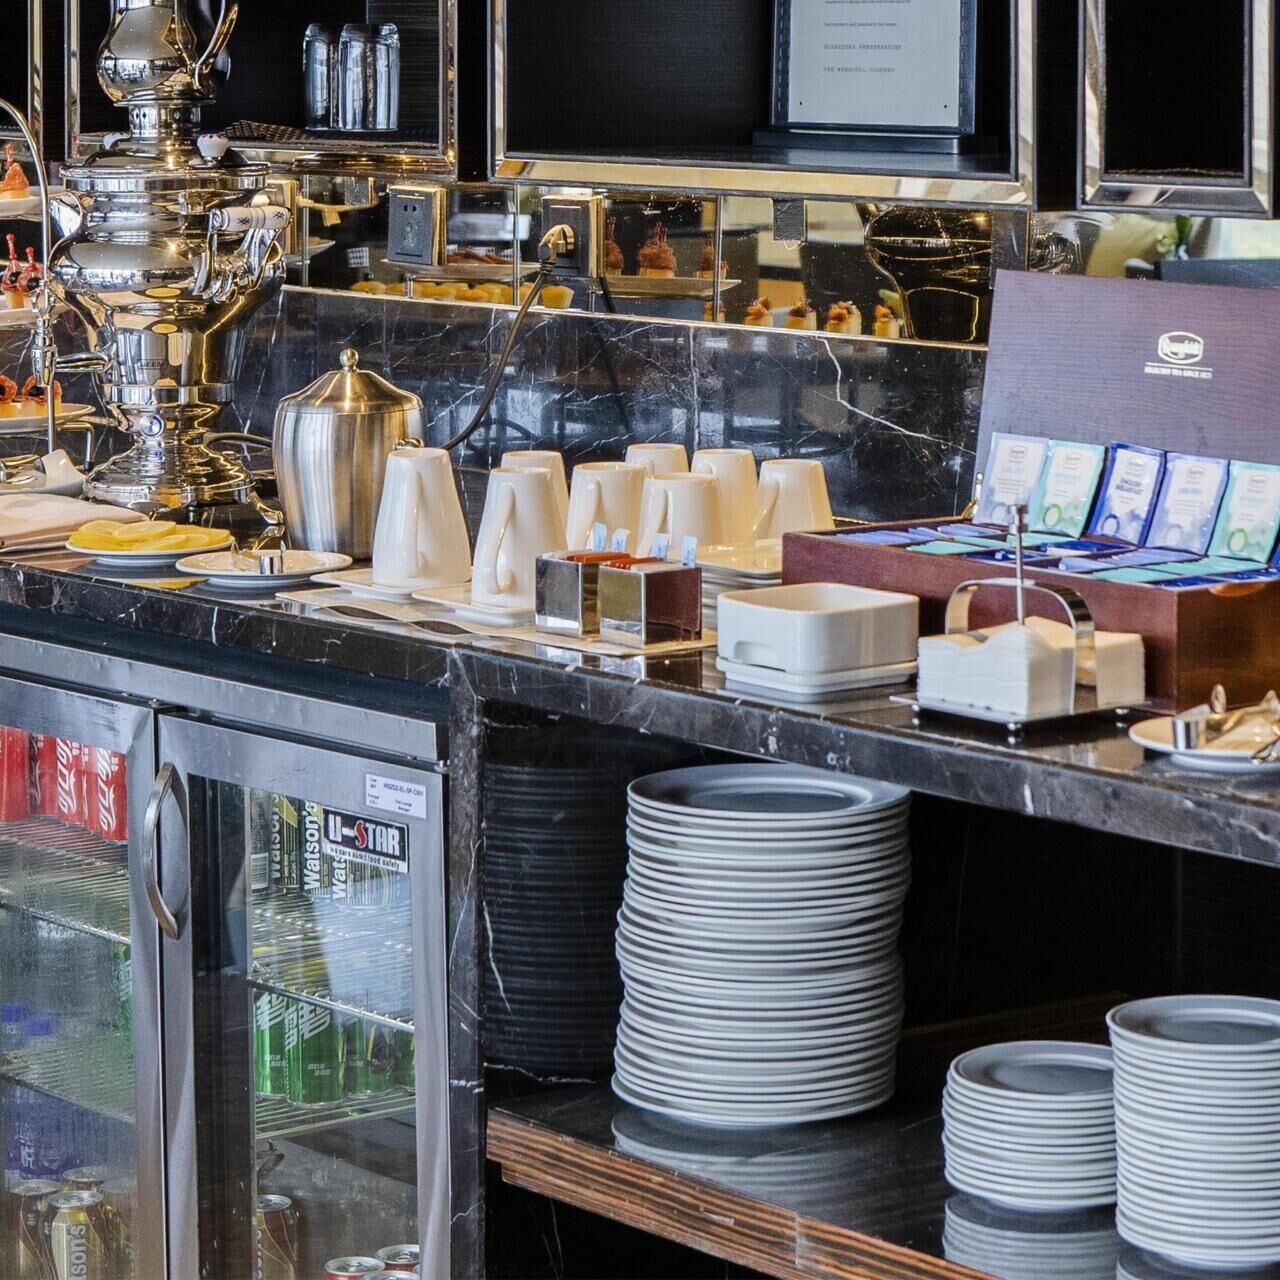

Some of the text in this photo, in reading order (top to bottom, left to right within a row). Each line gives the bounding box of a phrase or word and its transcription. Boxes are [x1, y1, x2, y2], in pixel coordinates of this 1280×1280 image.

[304, 799, 320, 891] Watson's
[328, 813, 400, 856] U-STAR
[368, 854, 381, 864] food
[382, 858, 400, 871] safety
